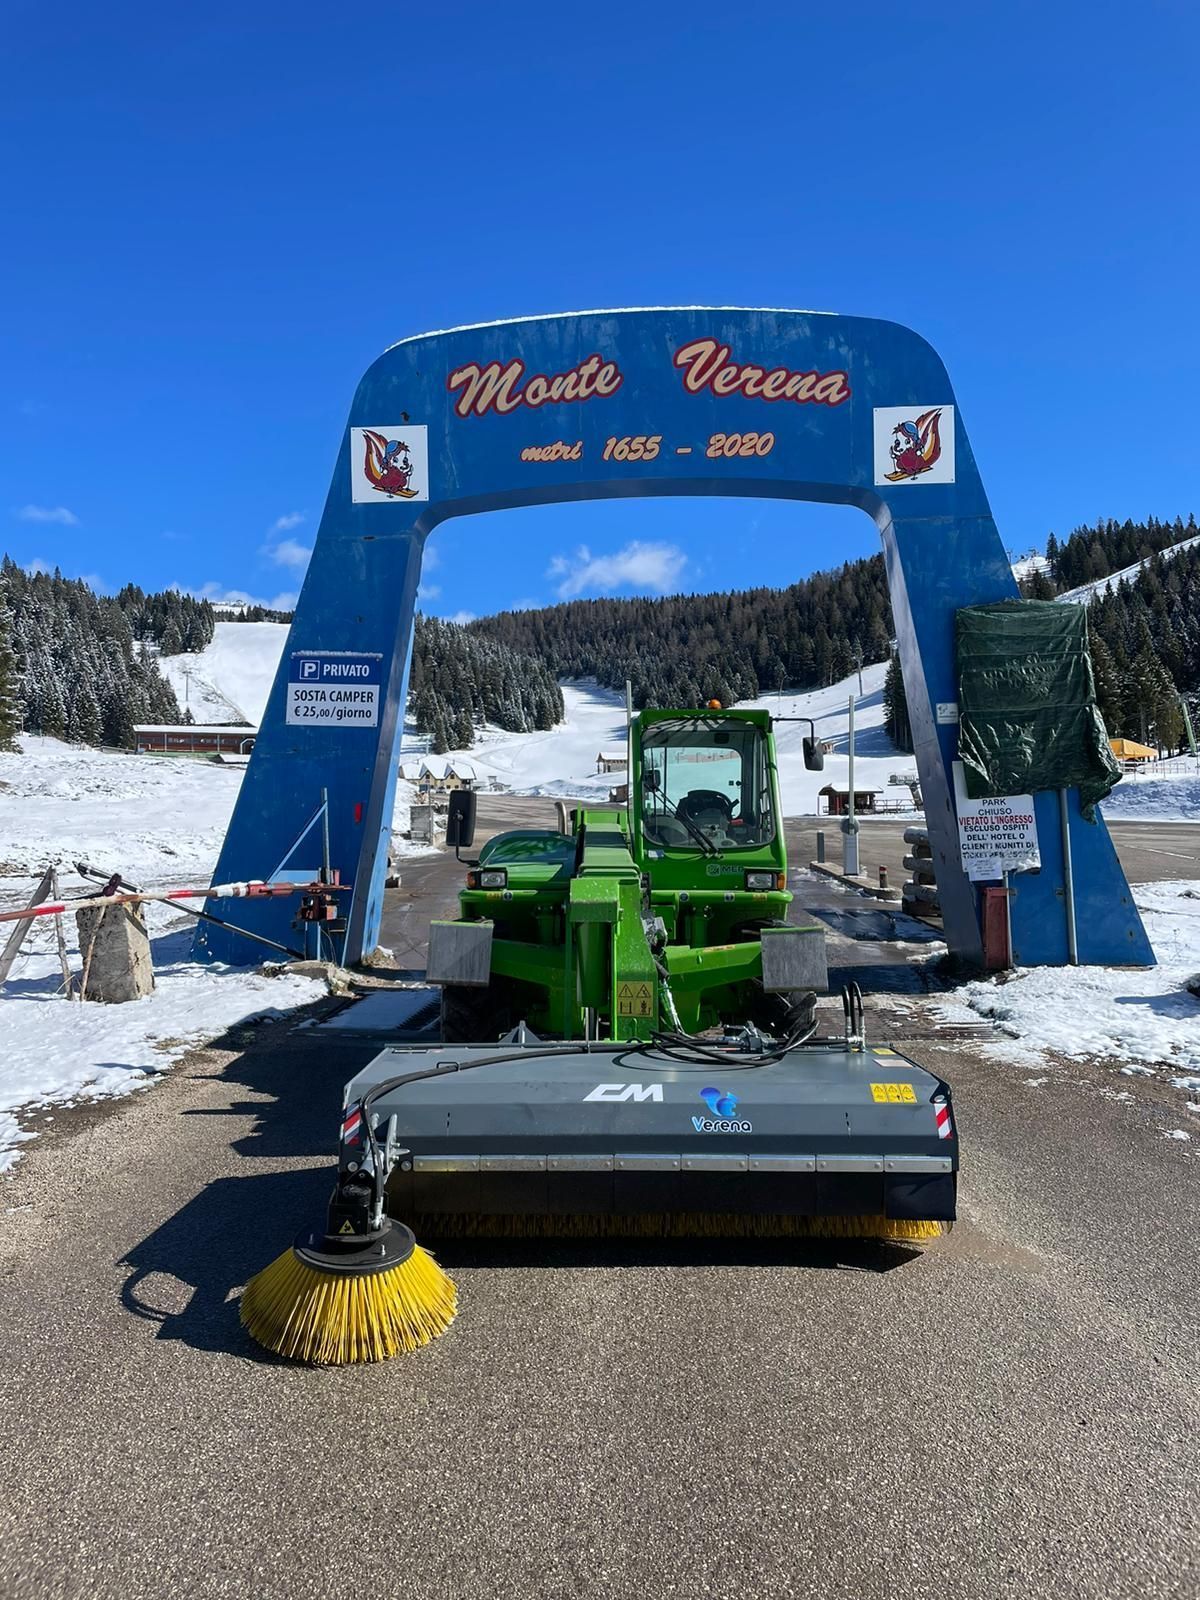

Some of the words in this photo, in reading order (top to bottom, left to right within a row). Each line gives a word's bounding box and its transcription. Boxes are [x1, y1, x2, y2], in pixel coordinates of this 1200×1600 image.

[448, 354, 622, 417] Monte
[674, 337, 851, 406] Verena
[520, 441, 583, 462] metri
[602, 436, 663, 462] 1655
[706, 432, 775, 457] 2020
[323, 664, 370, 677] PRIVATO
[294, 690, 327, 702] SOSTA
[329, 690, 374, 703] CAMPER
[982, 798, 1007, 806] PARK
[978, 808, 1012, 816] CHIUSO
[959, 816, 989, 825] VIETATO
[991, 815, 1033, 824] L'INGRESSO
[582, 1083, 664, 1102] CM
[691, 1116, 752, 1133] Verena
